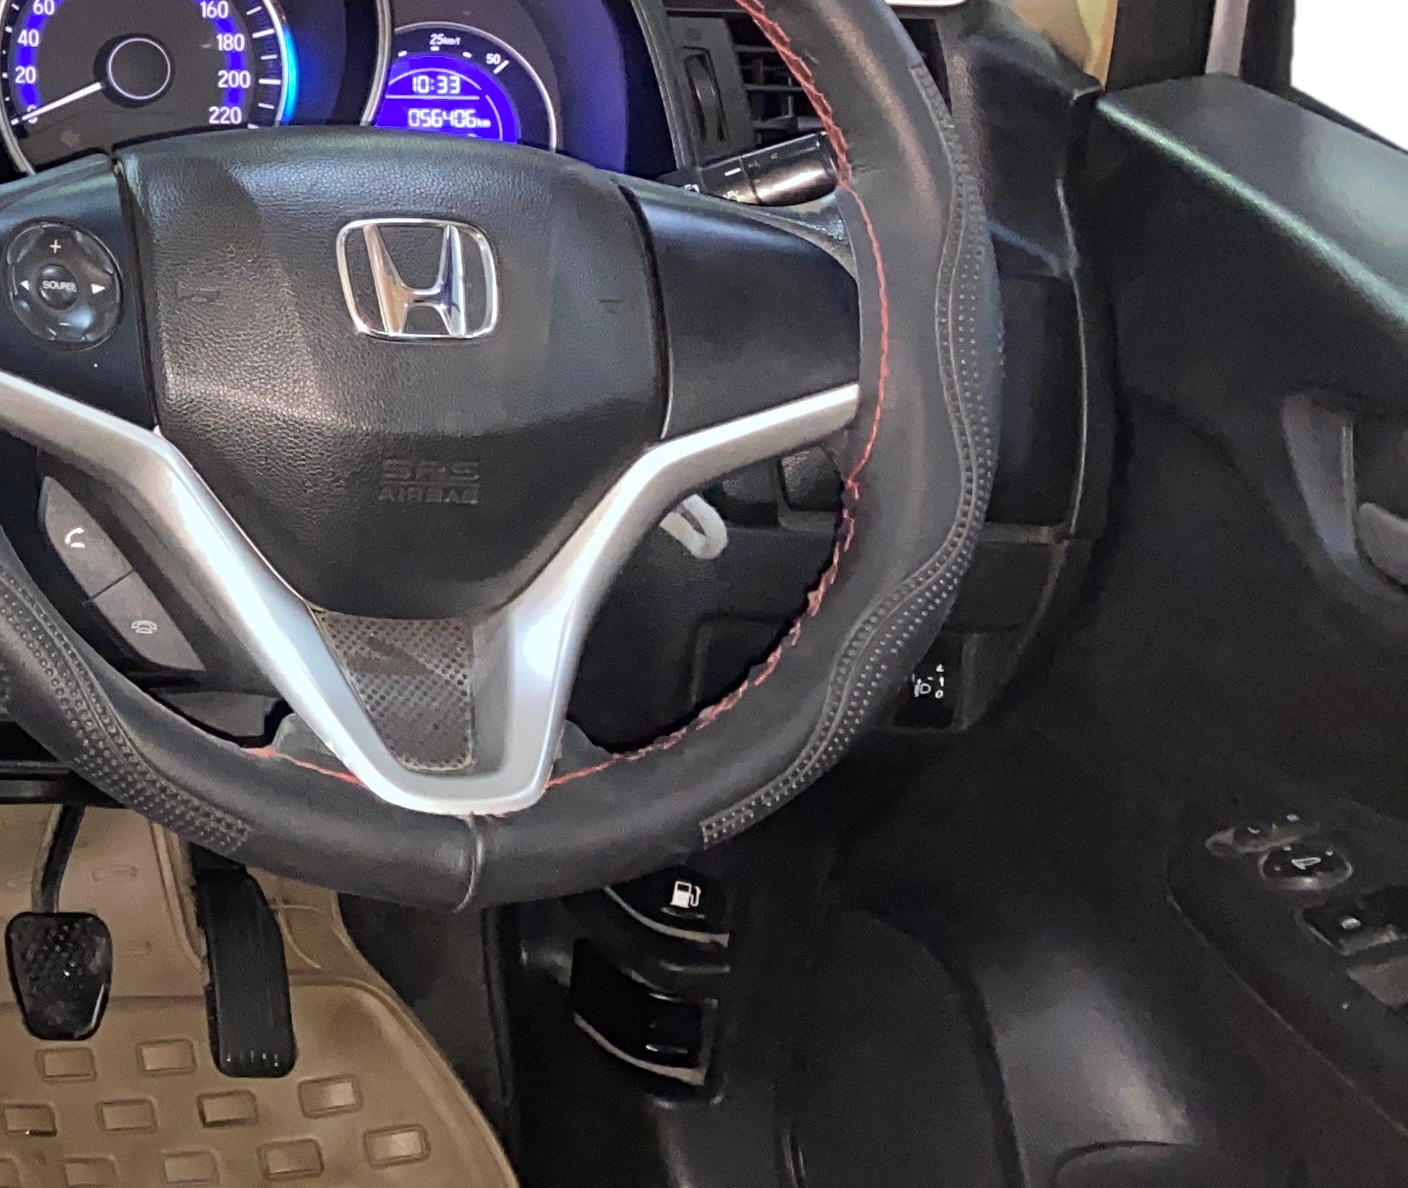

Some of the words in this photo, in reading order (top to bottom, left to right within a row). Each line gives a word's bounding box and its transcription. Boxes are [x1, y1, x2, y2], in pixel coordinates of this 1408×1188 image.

[201, 1, 229, 19] 160
[17, 29, 40, 48] 40
[216, 33, 245, 52] 180
[486, 53, 501, 65] 50
[15, 66, 36, 84] 20
[218, 70, 251, 88] 200
[412, 75, 461, 94] 10:33
[209, 106, 242, 125] 220
